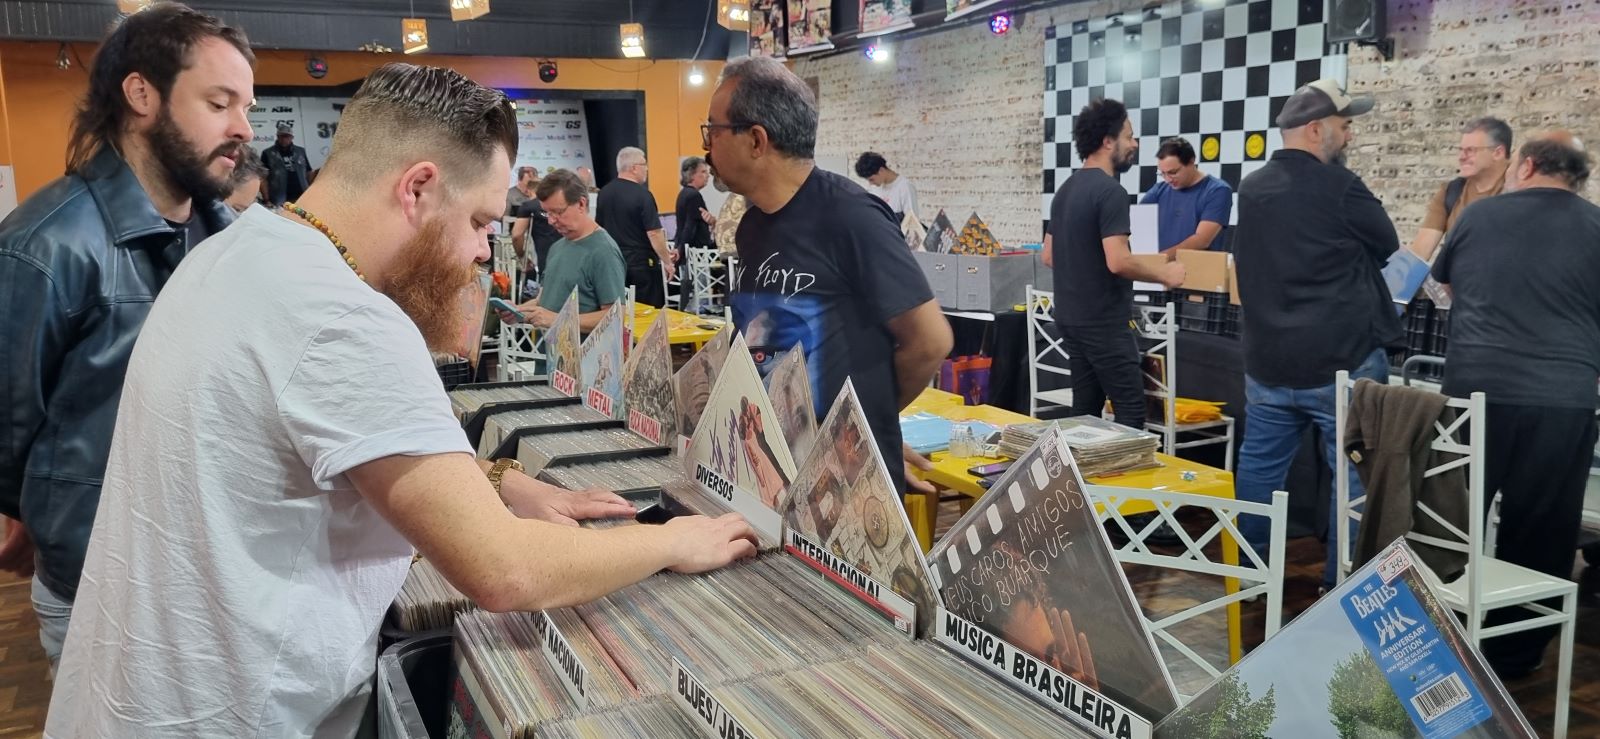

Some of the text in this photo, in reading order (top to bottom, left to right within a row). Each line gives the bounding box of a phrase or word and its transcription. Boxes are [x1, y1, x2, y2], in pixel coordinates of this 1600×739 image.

[565, 120, 582, 129] GS
[555, 371, 574, 396] ROCK
[588, 389, 611, 418] METAL
[696, 464, 734, 502] DIVERSOS
[971, 541, 1014, 587] CAROS
[1017, 479, 1084, 554] AMIGOS
[792, 532, 881, 599] INTERNACIONAL
[996, 524, 1073, 606] BUARQUE
[1351, 585, 1398, 619] BEATLES
[1381, 624, 1427, 660] ANNIVERSARY
[1392, 638, 1424, 661] EDITION
[548, 625, 585, 698] NACIONAL
[945, 613, 1132, 739] MUSICA BRASILEIRA
[718, 712, 755, 739] JAZ
